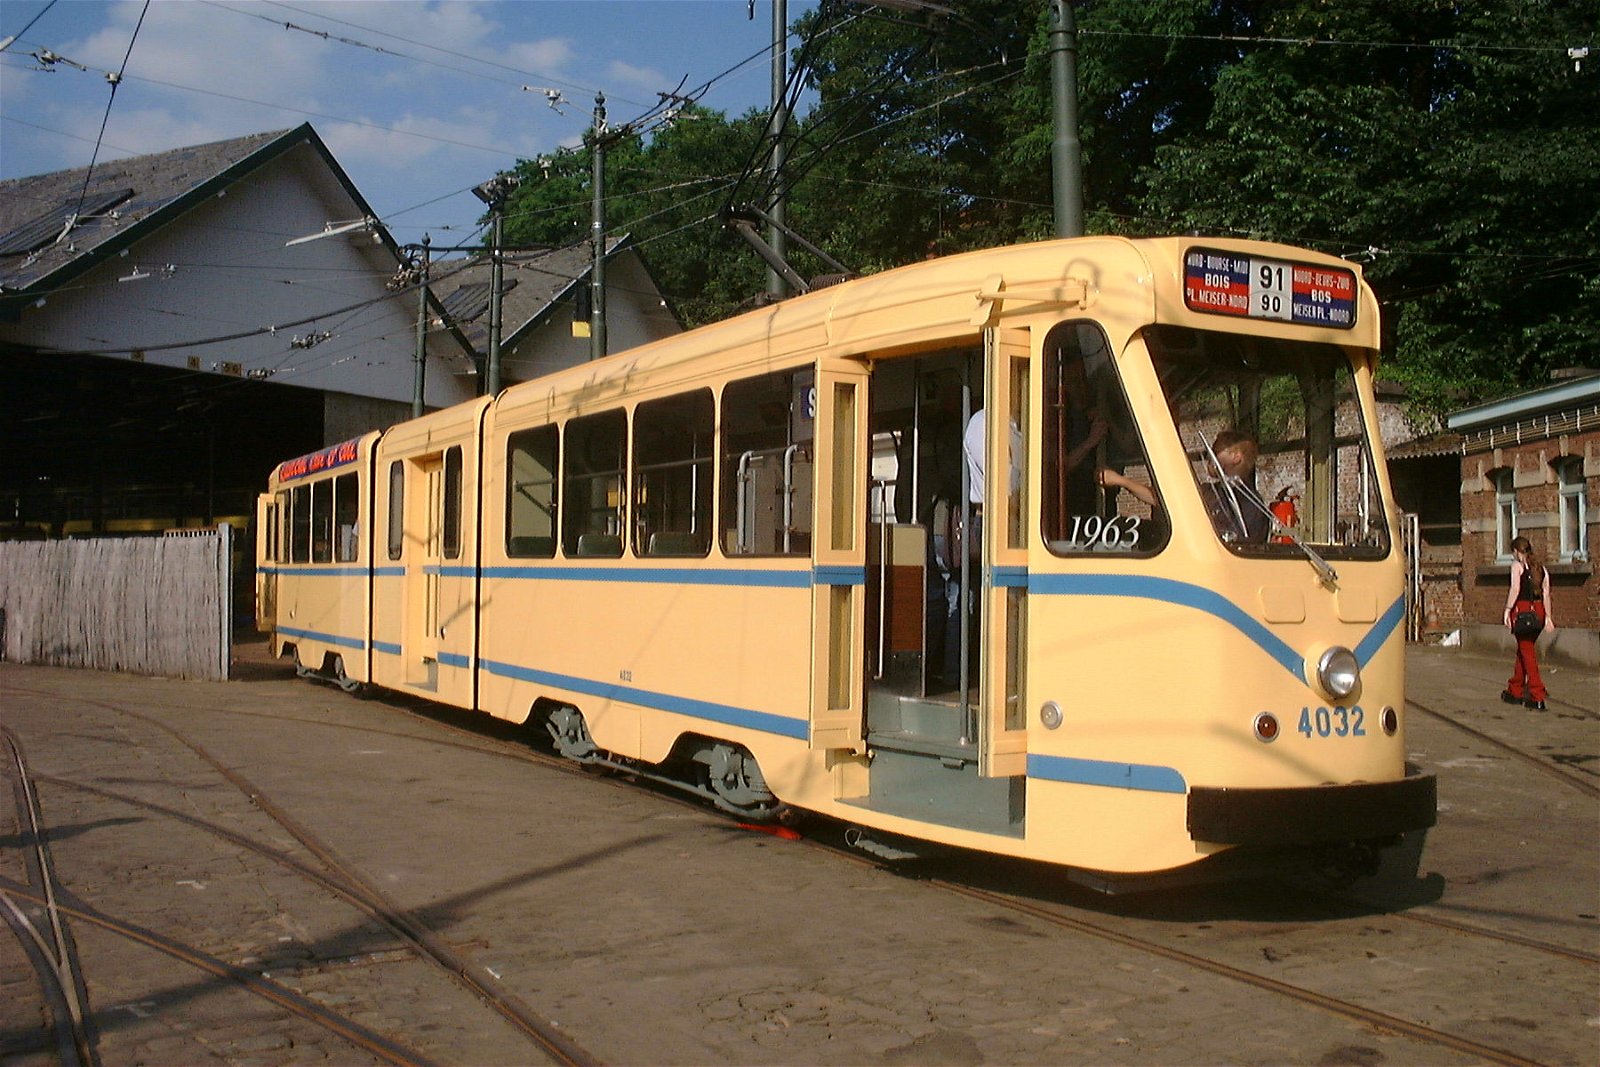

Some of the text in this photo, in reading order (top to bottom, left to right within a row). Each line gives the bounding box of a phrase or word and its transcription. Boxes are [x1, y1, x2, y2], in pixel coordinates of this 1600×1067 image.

[1205, 273, 1230, 289] BOIS
[1260, 265, 1283, 291] 91
[1261, 294, 1281, 312] 90
[1311, 289, 1331, 303] BOS
[1070, 515, 1140, 548] 1963
[1298, 705, 1366, 738] 4032
